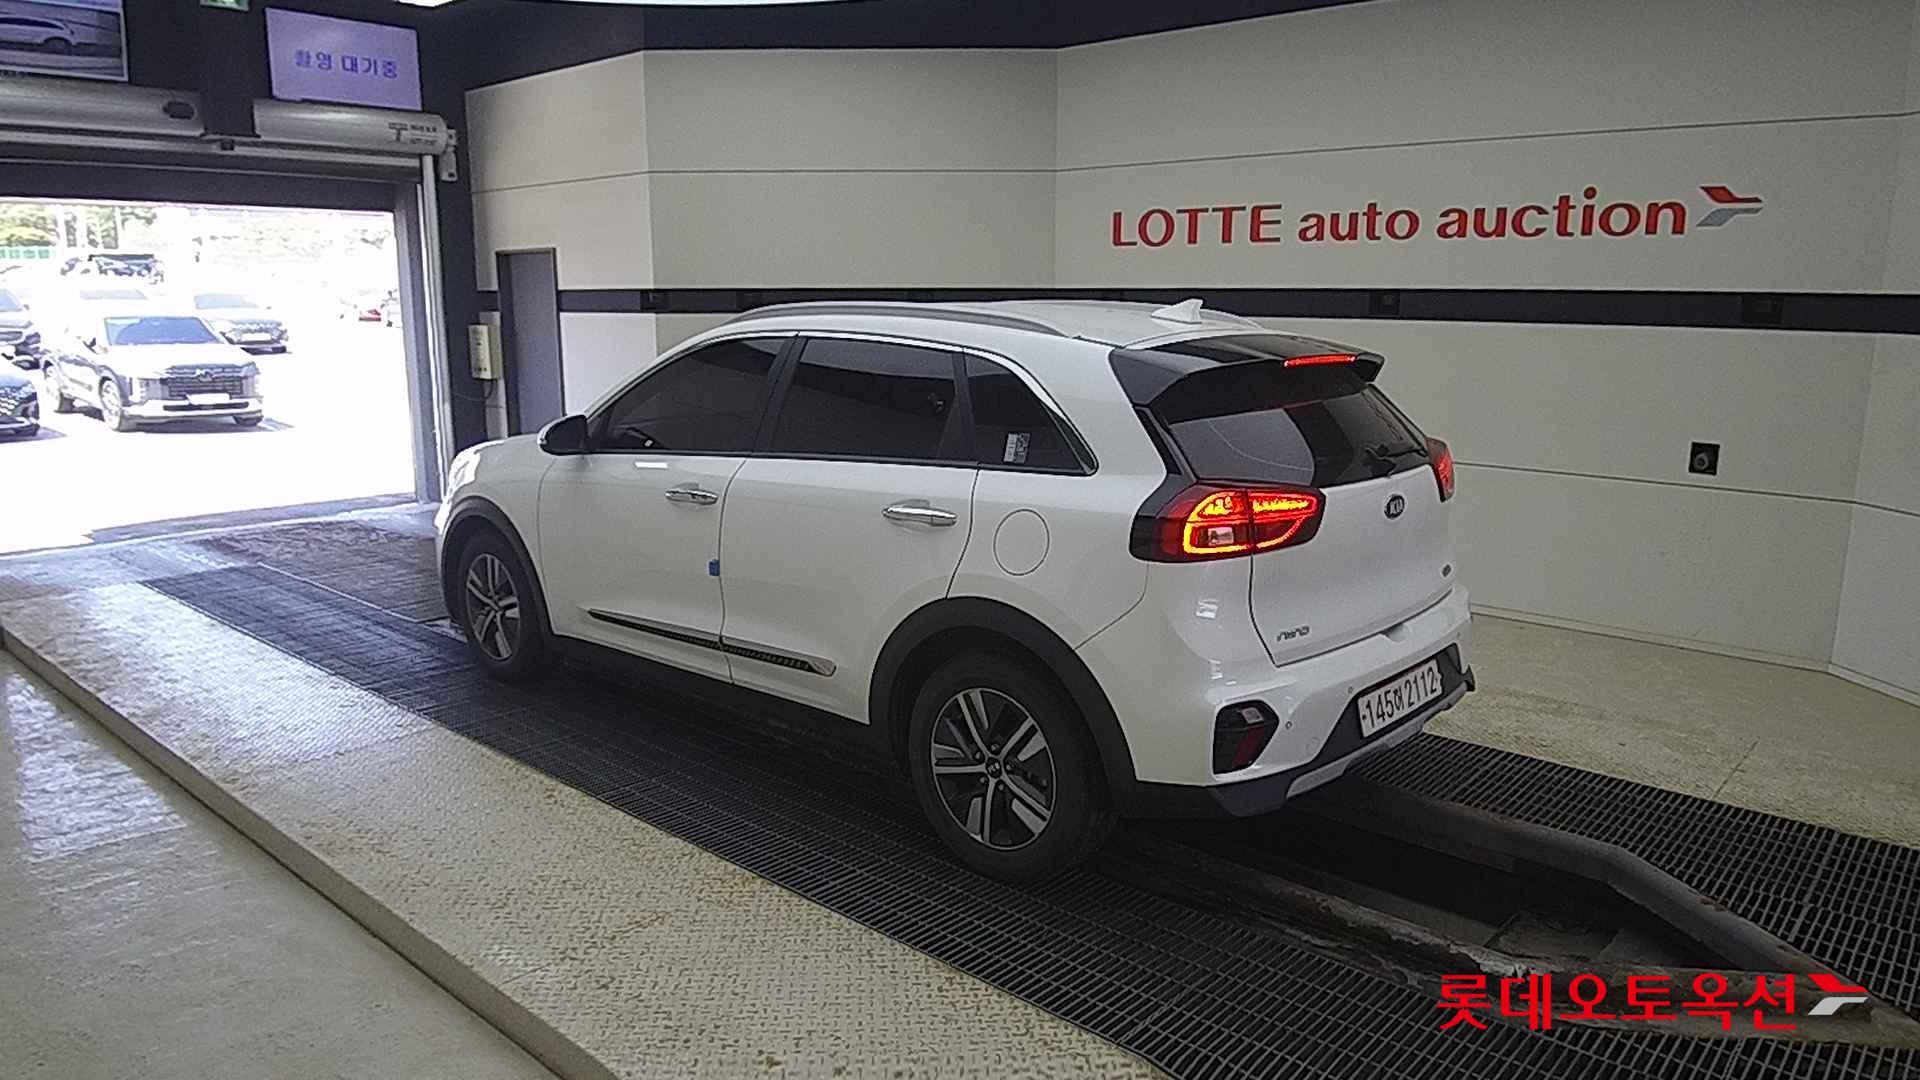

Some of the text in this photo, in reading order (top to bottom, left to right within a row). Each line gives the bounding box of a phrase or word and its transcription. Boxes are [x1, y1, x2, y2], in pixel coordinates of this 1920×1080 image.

[341, 55, 398, 79] 대기중
[1112, 186, 1687, 247] LOTTE auto auction
